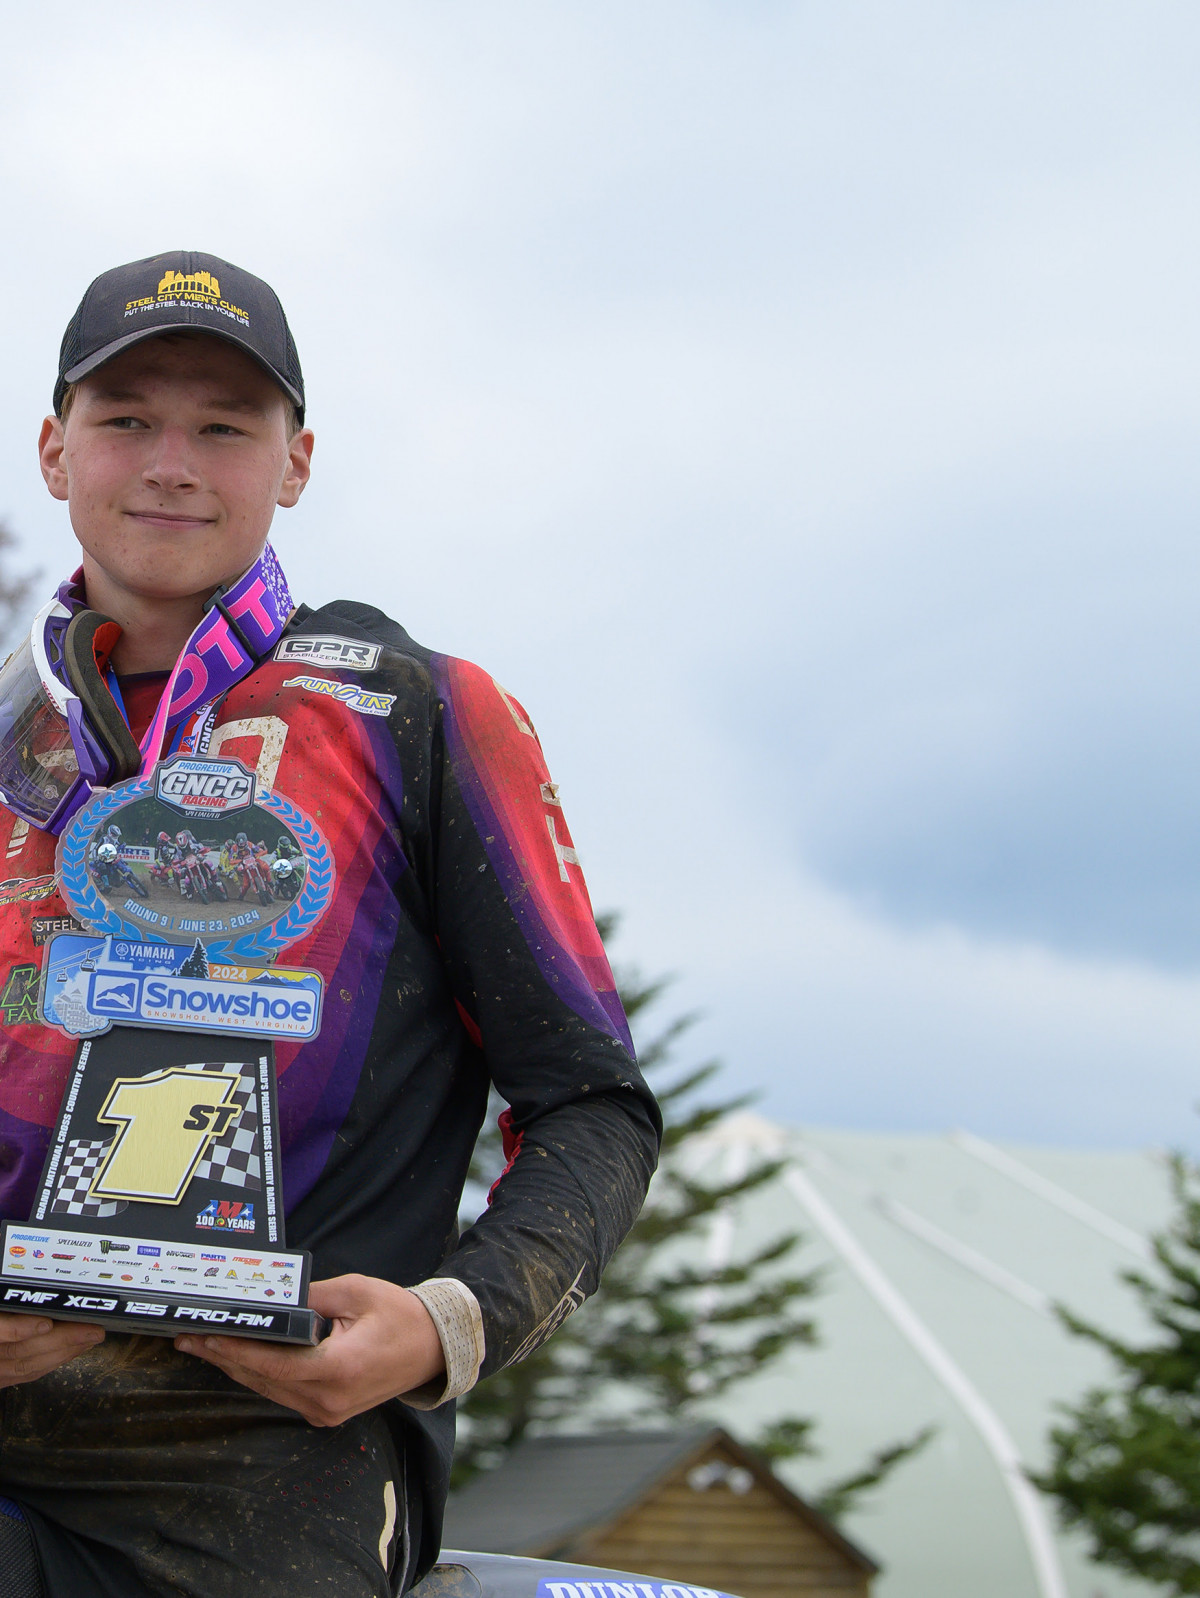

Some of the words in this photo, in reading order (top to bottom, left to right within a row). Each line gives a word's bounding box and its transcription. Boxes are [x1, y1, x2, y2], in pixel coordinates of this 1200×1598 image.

[124, 306, 138, 318] PUT
[140, 303, 155, 312] THE
[155, 300, 178, 309] STEEL
[180, 300, 203, 309] BACK
[205, 303, 213, 311] IN
[215, 306, 236, 321] YOUR
[236, 315, 250, 327] LIFE
[126, 296, 155, 310] STEEL
[157, 293, 184, 302] CITY
[184, 293, 218, 305] MEN'S
[219, 300, 250, 320] CLINIC
[285, 640, 371, 661] GPR
[178, 762, 234, 774] PROGRESSIVE
[161, 772, 249, 800] GNCC
[180, 795, 228, 808] RACING
[36, 919, 77, 932] STEEL
[123, 898, 159, 923] ROUND
[160, 915, 169, 927] 9
[178, 920, 206, 932] JUNE
[208, 920, 228, 932] 23,
[230, 909, 260, 929] 2024
[130, 944, 175, 961] YAMAHA
[211, 965, 248, 981] 2024
[144, 982, 312, 1022] Snowshoe
[147, 1010, 211, 1023] SNOWSHOE,
[218, 1017, 247, 1025] WEST
[255, 1020, 307, 1031] VIRGINIA
[258, 1056, 269, 1090] WORLD'S
[260, 1091, 271, 1125] PREMIER
[35, 1188, 50, 1221] GRAND
[45, 1144, 64, 1188] NATIONAL
[57, 1113, 72, 1143] CROSS
[65, 1071, 84, 1113] COUNTRY
[77, 1040, 92, 1071] SERIES
[263, 1125, 272, 1150] CROSS
[264, 1151, 275, 1186] COUNTRY
[197, 1199, 256, 1221] AMA
[266, 1187, 276, 1216] RACING
[196, 1215, 214, 1226] 100
[227, 1217, 256, 1230] YEARS
[268, 1216, 278, 1243] SERIES
[10, 1233, 51, 1243] PROGRESSIVE
[57, 1238, 93, 1248] SPECIALIZED
[3, 1288, 59, 1304] FMF
[64, 1294, 118, 1311] XC3
[124, 1301, 168, 1316] 125
[174, 1306, 275, 1328] PRO-AM
